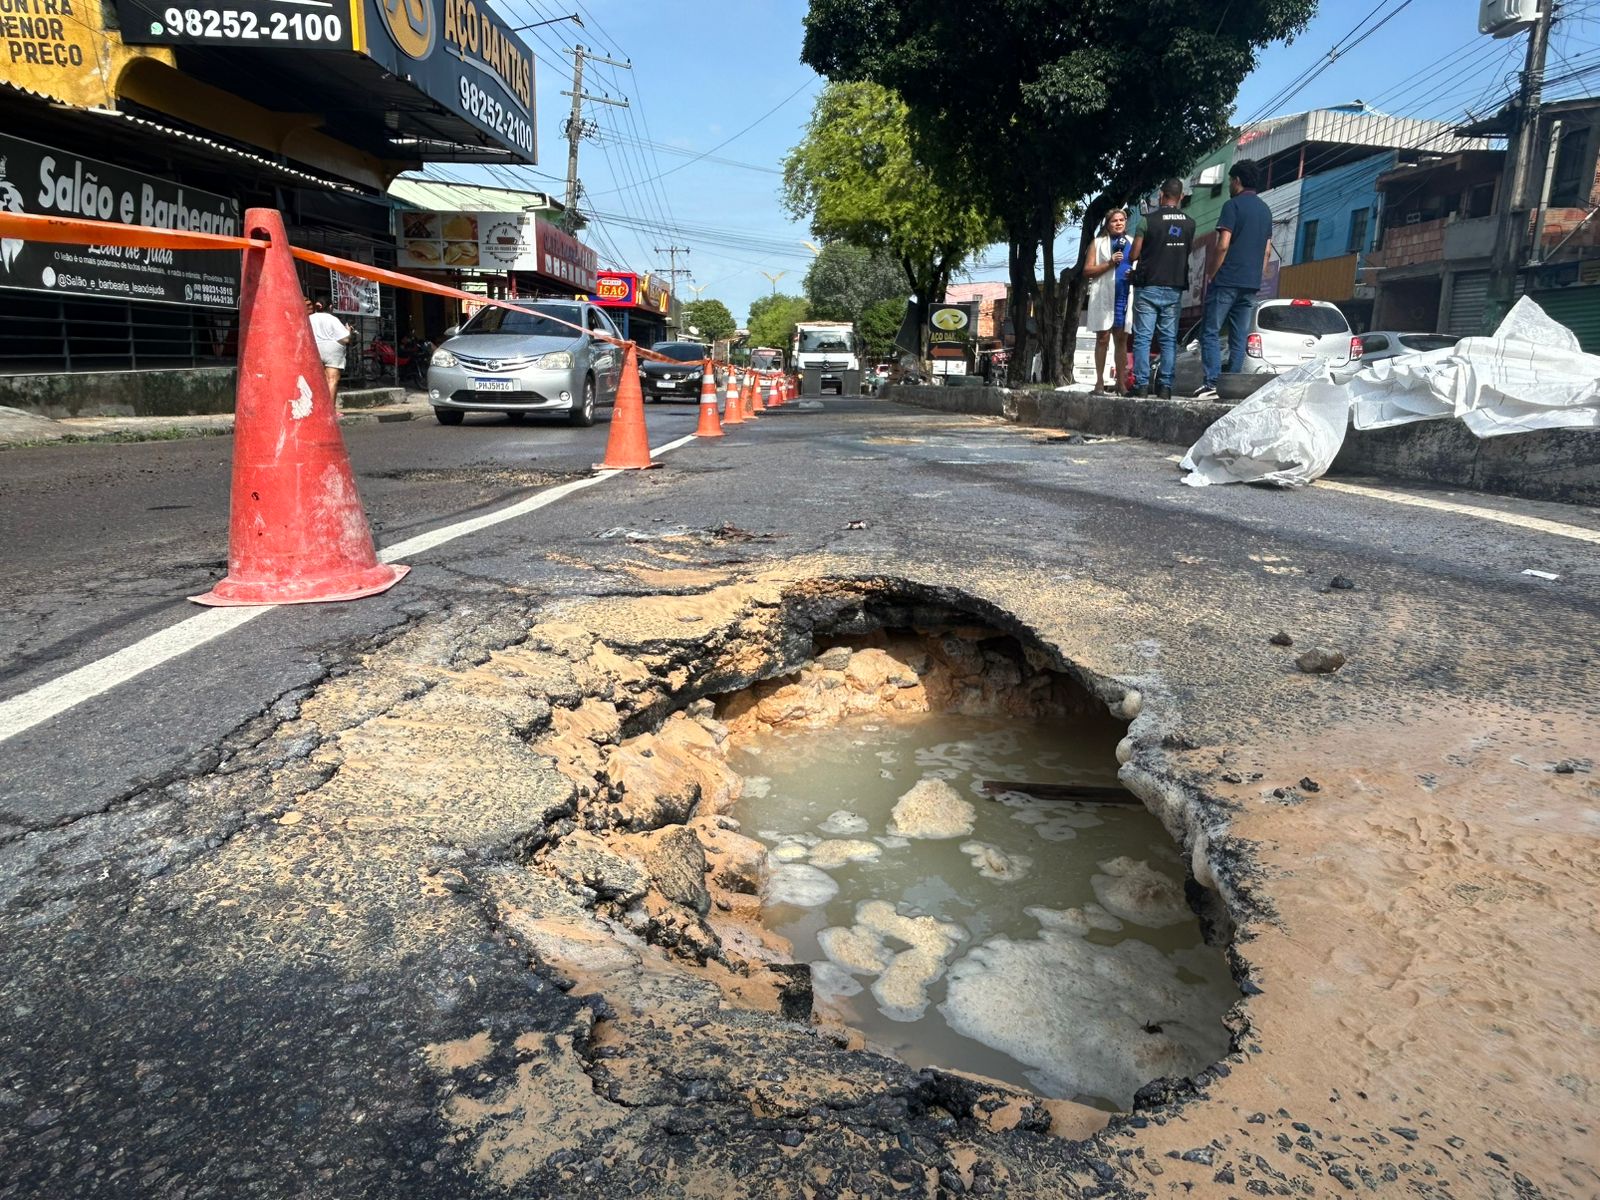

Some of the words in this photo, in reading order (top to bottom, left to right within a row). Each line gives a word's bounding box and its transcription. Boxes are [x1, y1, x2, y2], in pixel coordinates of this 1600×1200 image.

[0, 0, 73, 16] ONTRA
[164, 7, 342, 42] 98252-2100
[8, 41, 83, 67] PREÇO
[444, 0, 479, 62] AÇO
[481, 12, 530, 109] DANTAS
[460, 75, 533, 153] 98252-2100
[38, 155, 114, 220] Salão
[120, 191, 135, 224] e
[140, 183, 235, 237] Barbearia
[54, 251, 61, 260] O
[83, 256, 97, 265] mais
[97, 258, 120, 268] poderoso
[120, 261, 127, 269] de
[127, 262, 141, 271] todos
[599, 285, 625, 295] ISAC
